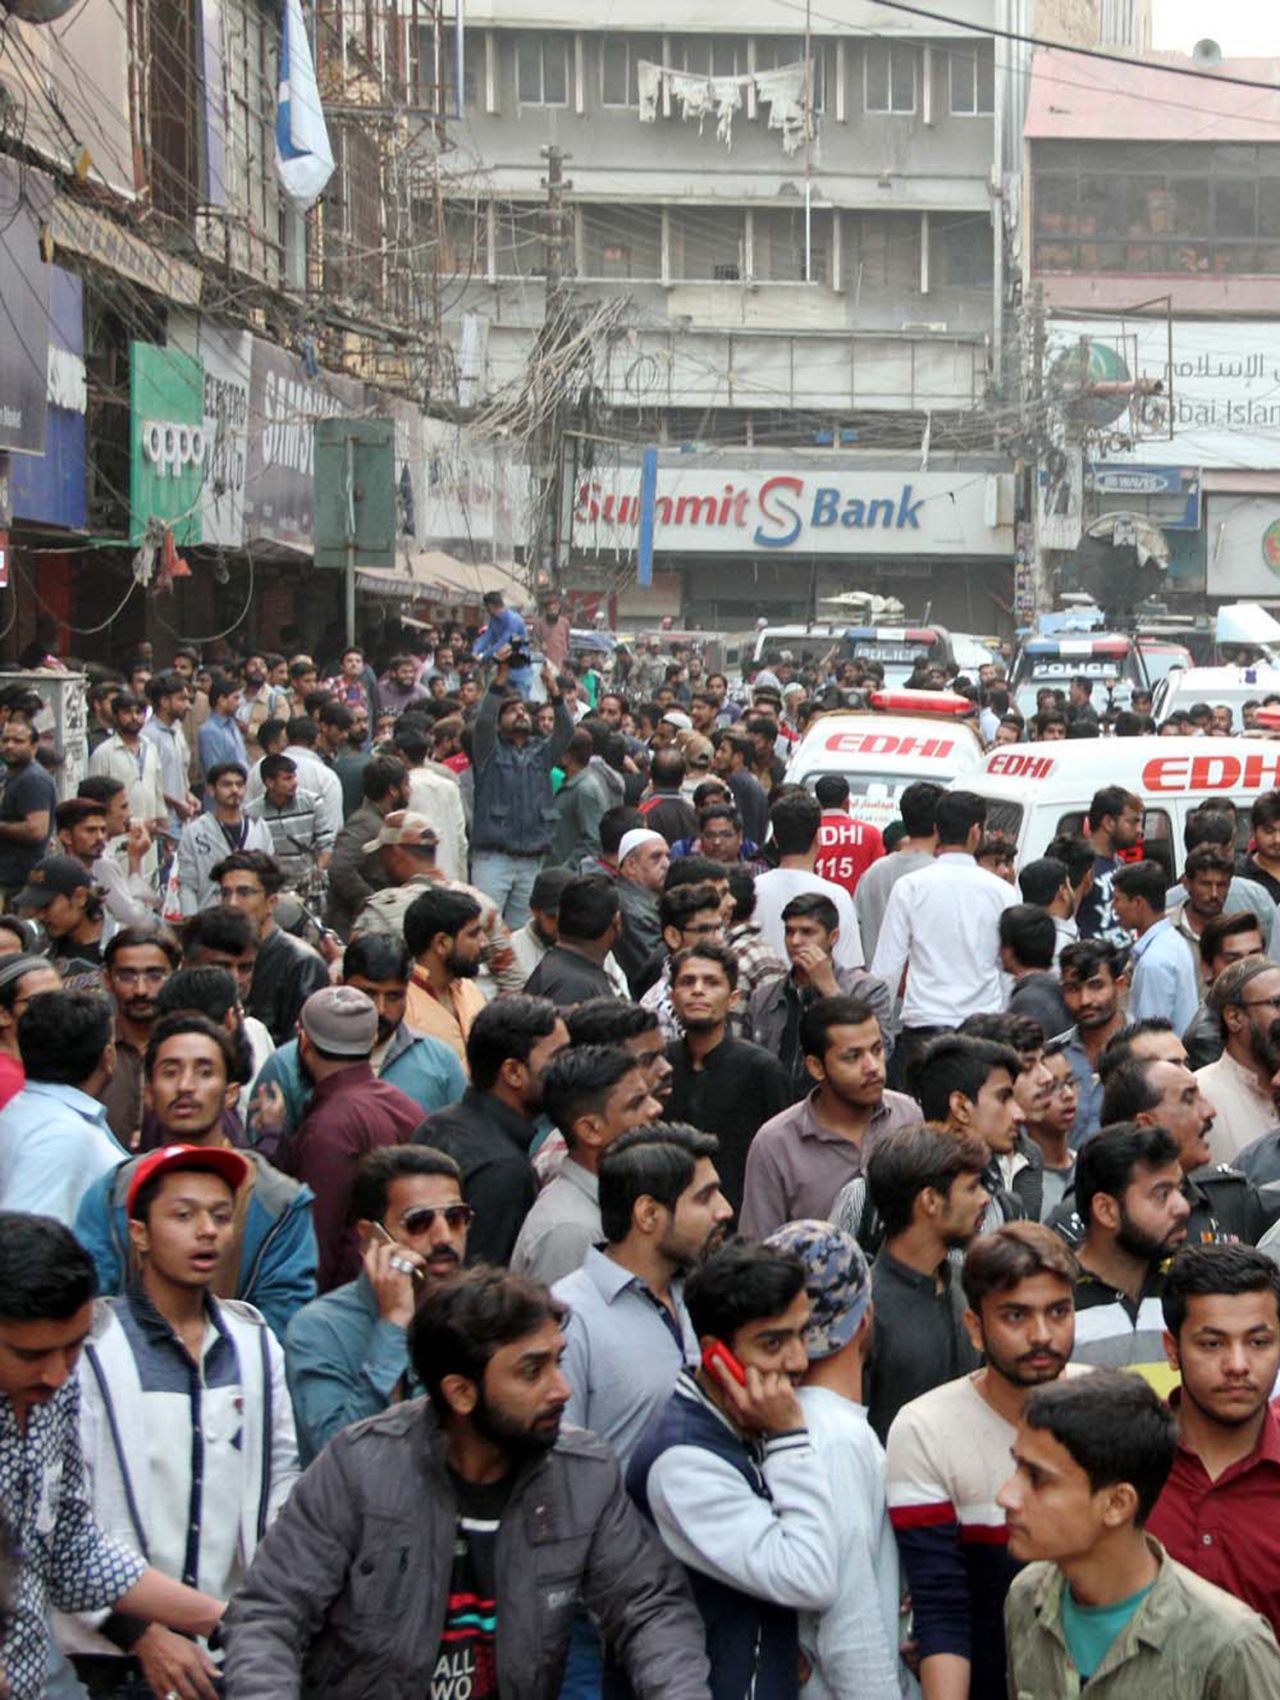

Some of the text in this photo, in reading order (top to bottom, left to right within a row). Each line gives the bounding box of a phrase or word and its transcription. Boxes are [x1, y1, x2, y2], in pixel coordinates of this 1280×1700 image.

[1142, 399, 1216, 425] Dbai
[143, 419, 206, 478] oppo
[573, 483, 751, 529] Summit
[809, 484, 926, 529] Bank
[1032, 663, 1119, 677] POLICE
[825, 732, 955, 759] EDHI
[986, 753, 1055, 780] EDHI
[195, 832, 212, 856] S
[817, 825, 864, 847] DHI
[433, 1647, 477, 1679] ALL
